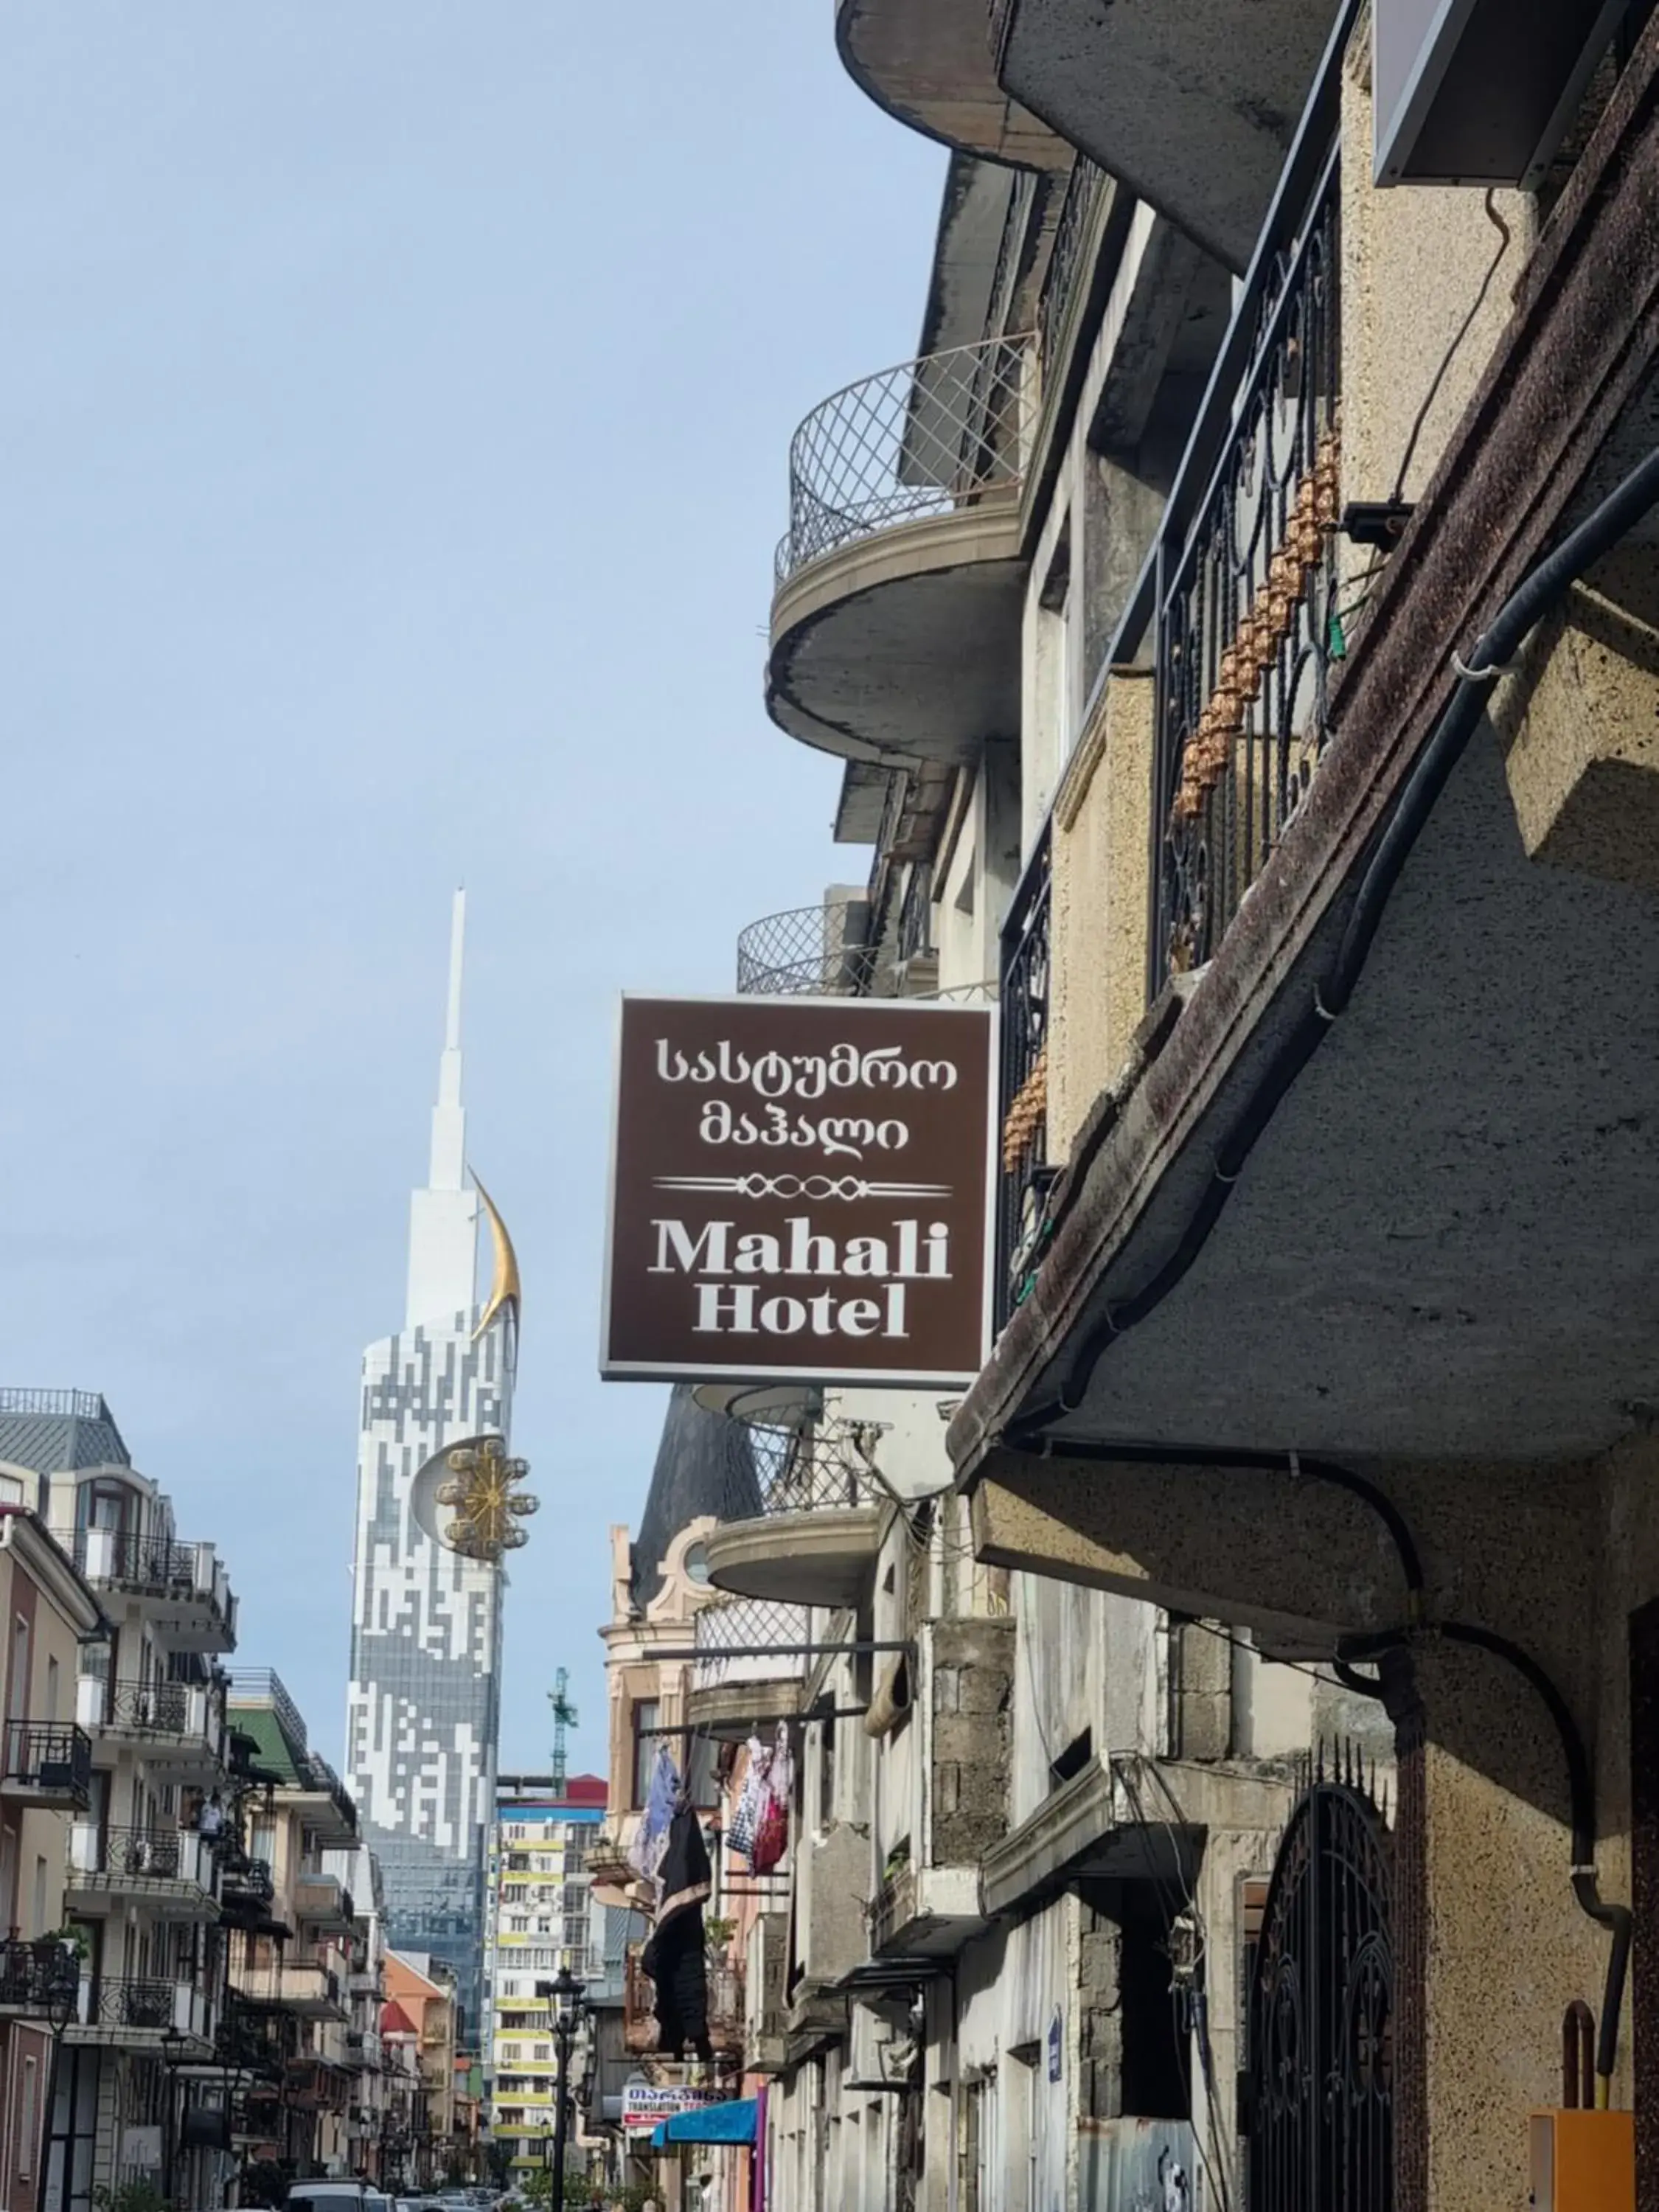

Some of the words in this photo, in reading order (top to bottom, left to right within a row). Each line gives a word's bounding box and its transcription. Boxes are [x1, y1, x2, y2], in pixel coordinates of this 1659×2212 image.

[655, 1038, 958, 1099] სასტუმრო
[700, 1099, 909, 1161] მაჰალი
[647, 1217, 953, 1279] Mahali
[692, 1283, 910, 1338] Hotel
[629, 2101, 681, 2112] TRANSLATION
